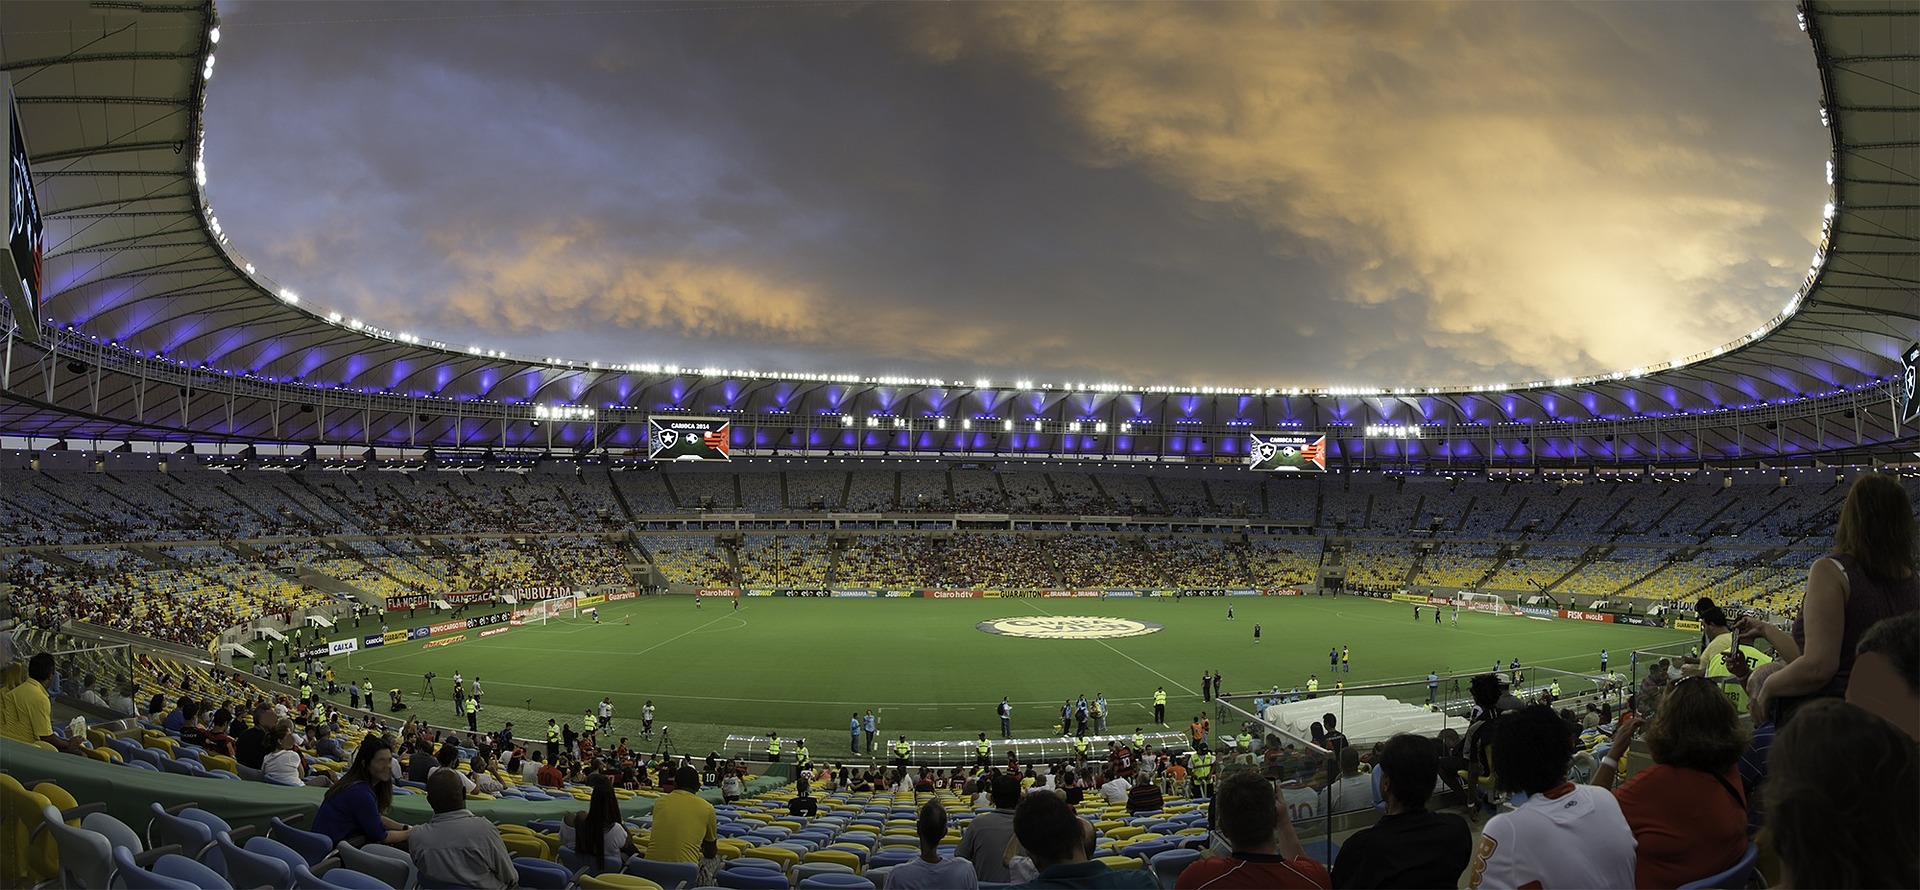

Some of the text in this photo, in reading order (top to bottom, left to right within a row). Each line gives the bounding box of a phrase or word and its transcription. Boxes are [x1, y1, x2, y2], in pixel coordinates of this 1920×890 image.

[1567, 611, 1583, 620] FISK
[334, 642, 353, 651] CAIXA
[1122, 757, 1130, 768] 10
[706, 774, 715, 782] 10
[1289, 802, 1313, 820] 10
